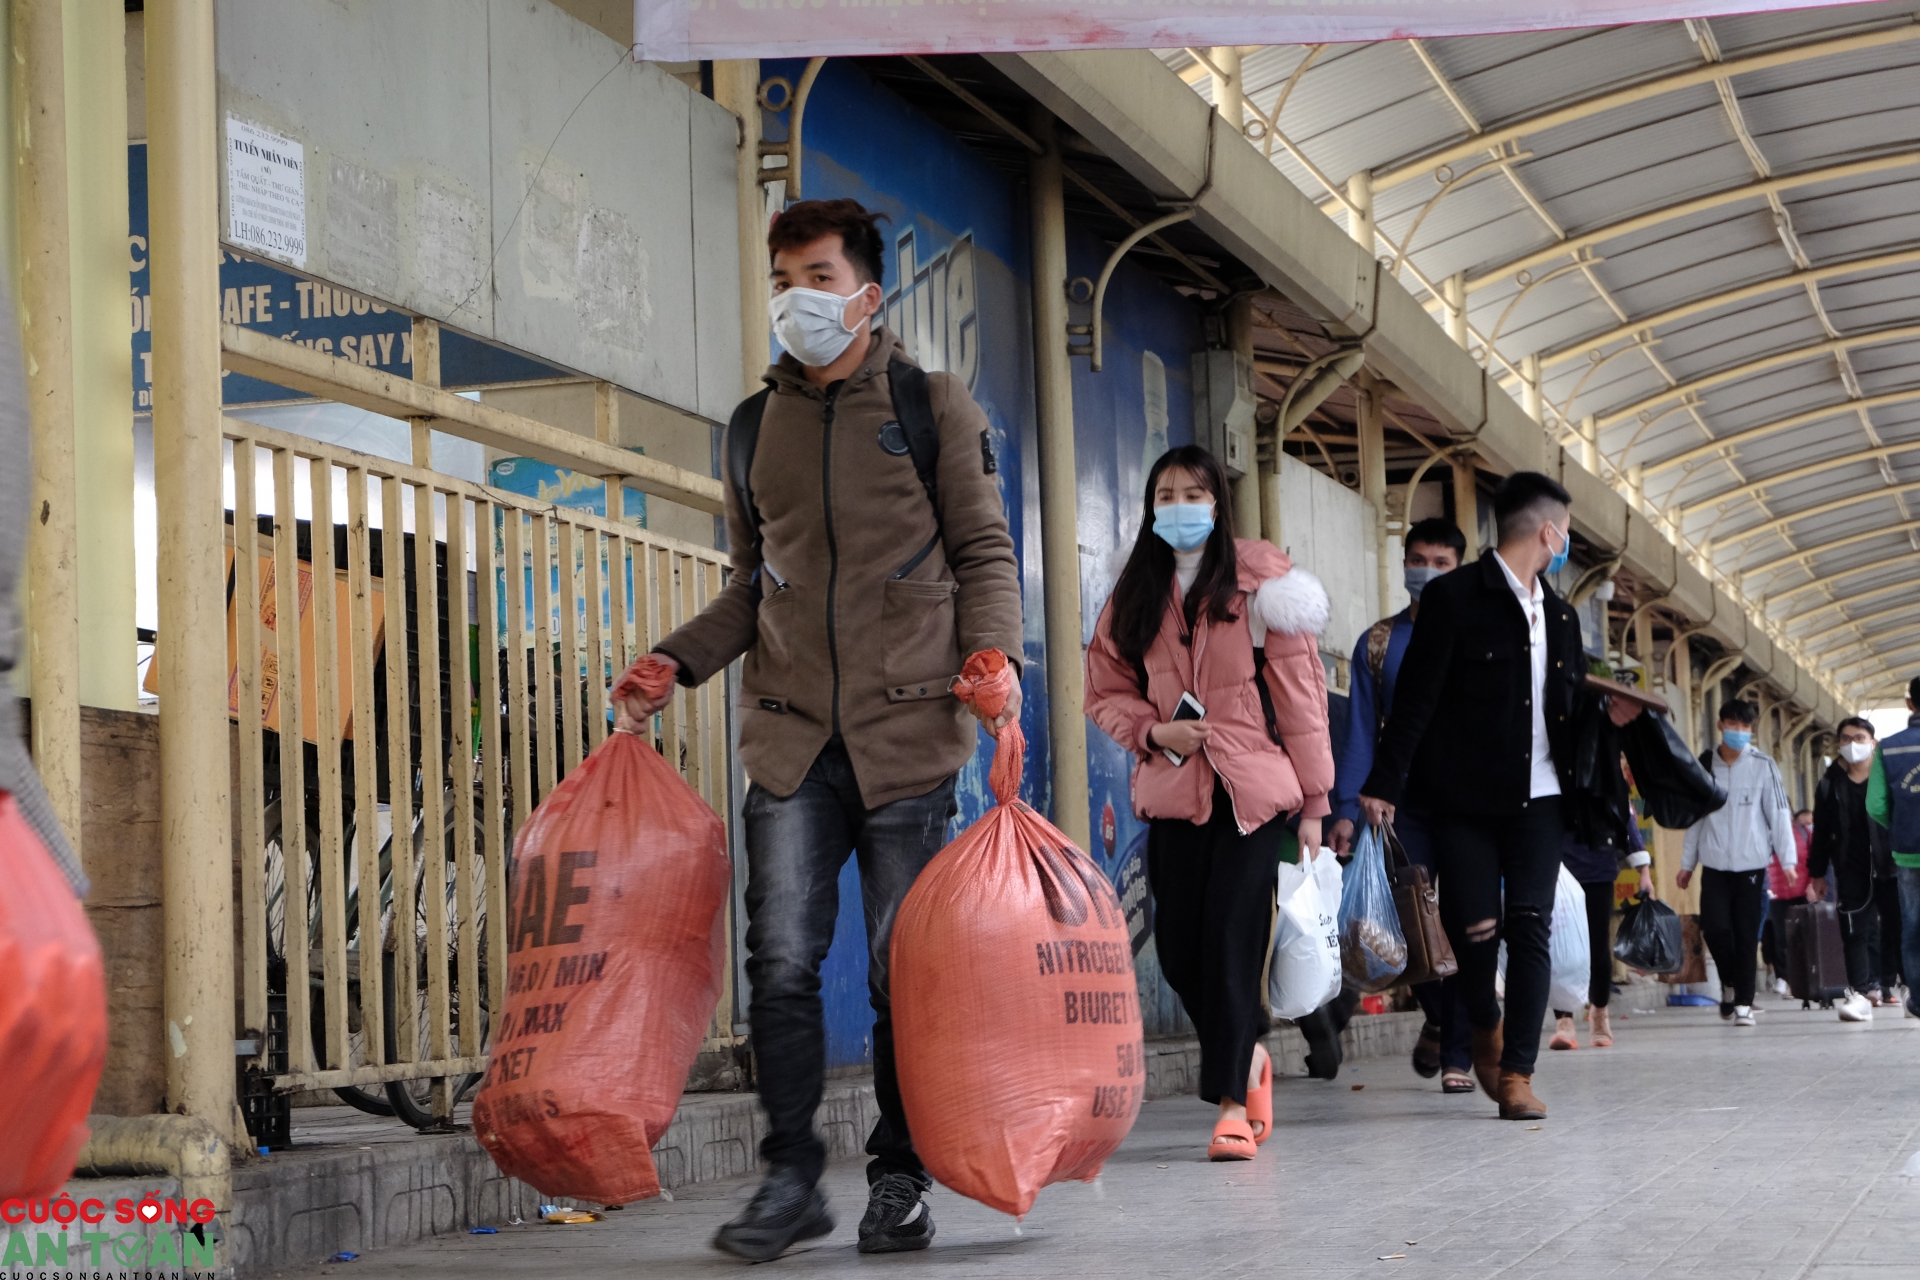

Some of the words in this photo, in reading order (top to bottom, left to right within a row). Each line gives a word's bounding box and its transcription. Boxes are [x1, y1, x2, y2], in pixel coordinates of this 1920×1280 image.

[241, 125, 288, 147] 086.232.9999
[234, 139, 259, 157] TUYỂN
[261, 149, 282, 165] NHÂN
[282, 156, 299, 171] VIÊN
[234, 220, 304, 256] LH:086.232.9999
[219, 285, 273, 325] AFE
[553, 951, 607, 988] MIN
[1064, 990, 1128, 1025] BIURET
[498, 1046, 538, 1083] NET
[1092, 1085, 1128, 1119] USE
